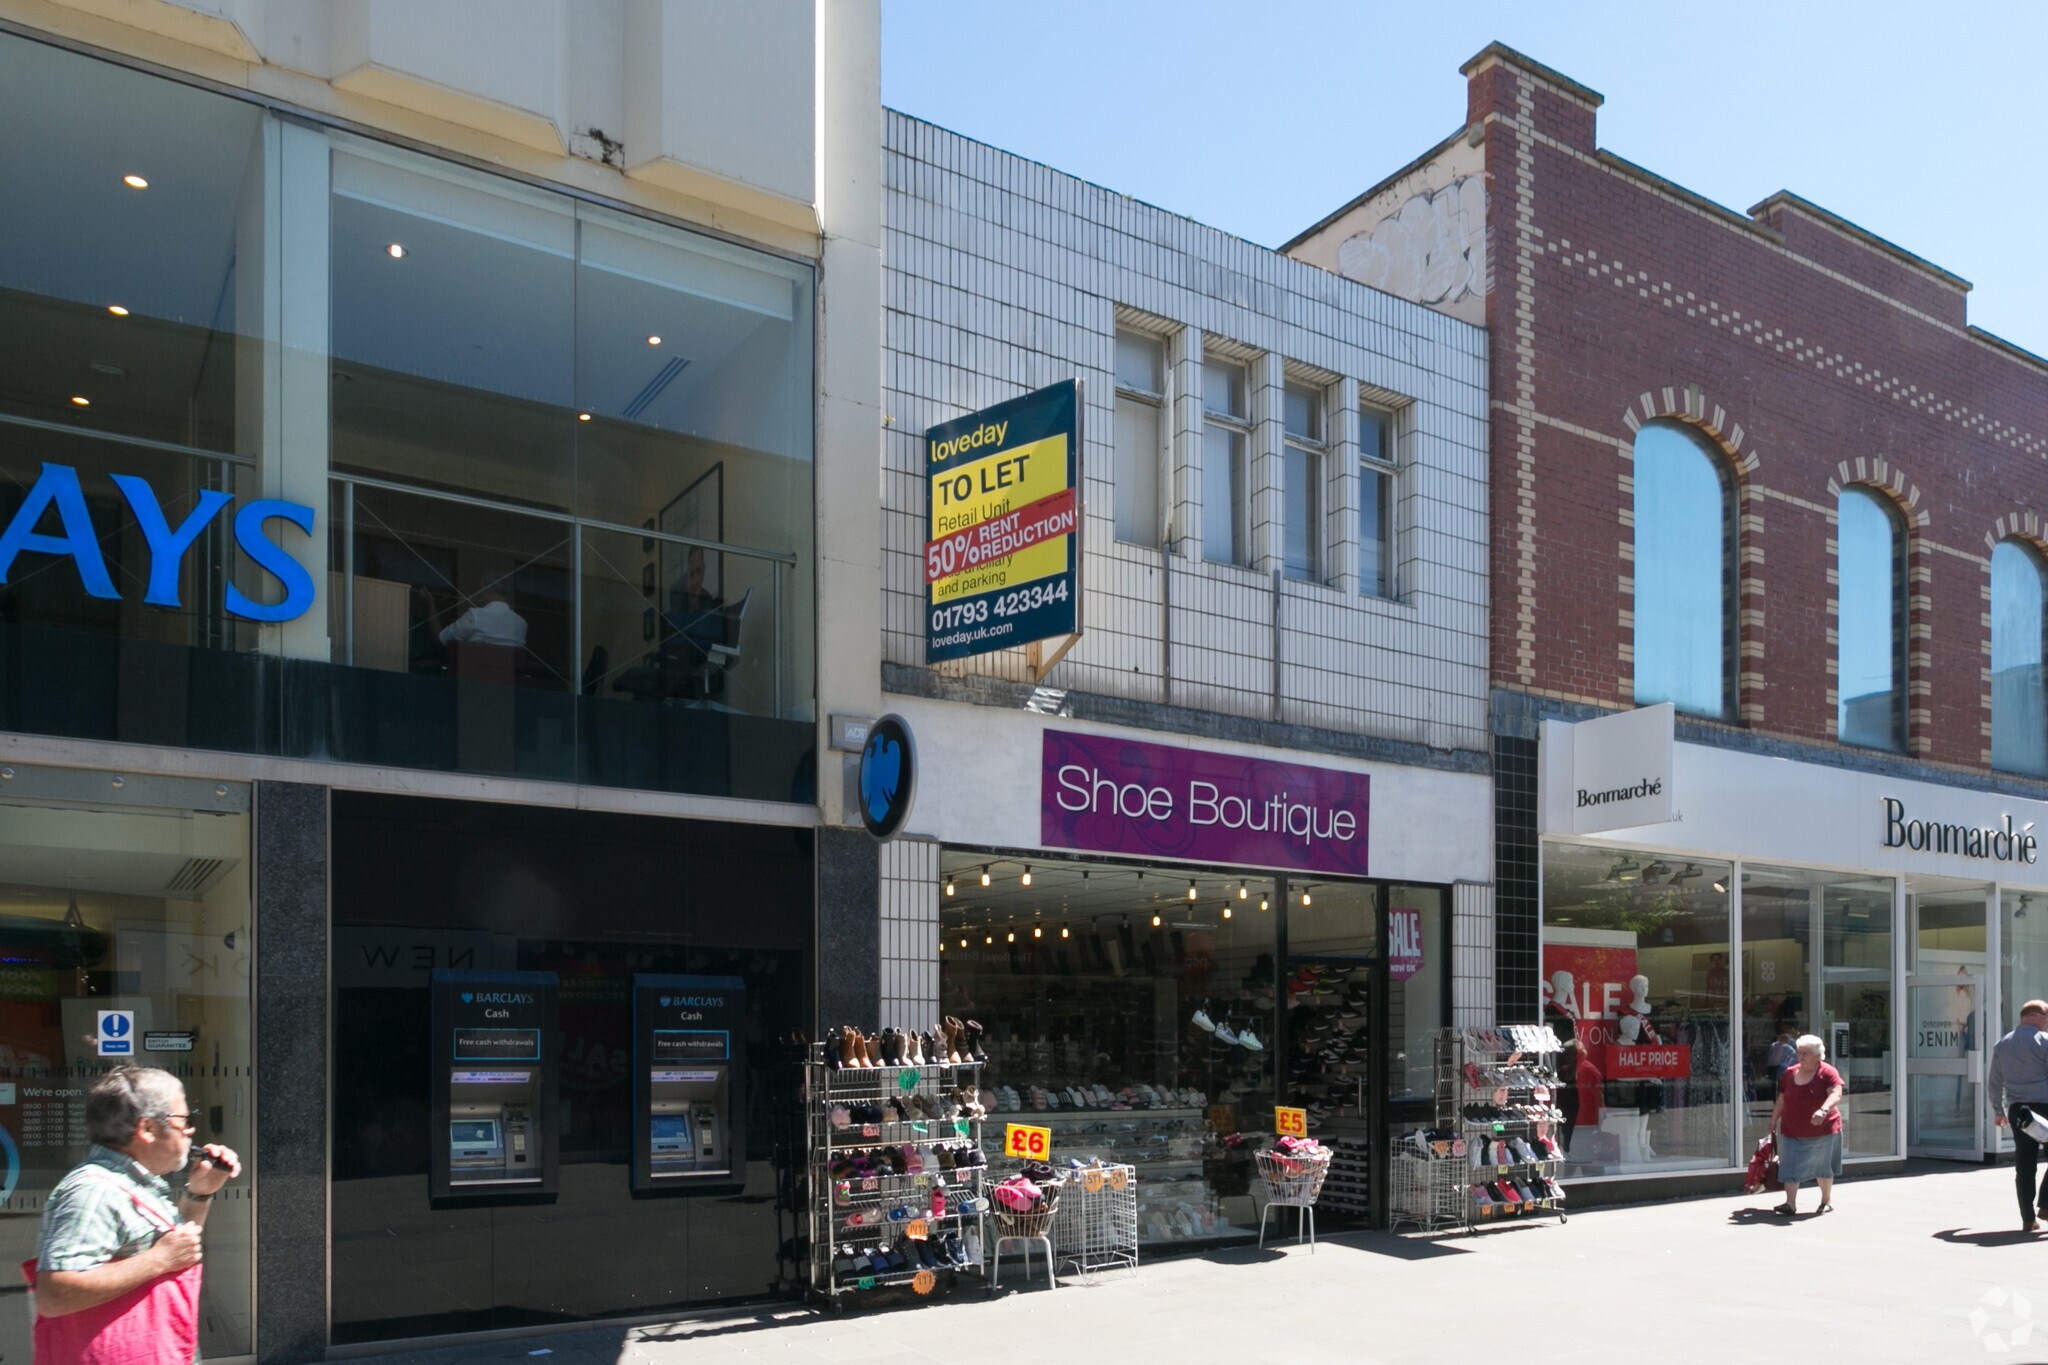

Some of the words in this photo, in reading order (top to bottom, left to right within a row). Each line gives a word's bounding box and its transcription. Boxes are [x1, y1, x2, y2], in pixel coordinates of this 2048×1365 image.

[932, 421, 1008, 462] loveday
[939, 474, 972, 506] TO
[981, 454, 1030, 493] LET
[938, 507, 977, 533] Retail
[982, 498, 1011, 521] Unit
[928, 531, 980, 578] 50%
[979, 512, 1020, 543] RENT
[980, 509, 1074, 560] REDUCTION
[938, 581, 959, 597] and
[962, 570, 1007, 593] parking
[932, 602, 989, 632] 01793
[993, 579, 1069, 617] 423344
[932, 622, 1013, 649] loveday.uk.com
[1056, 764, 1173, 821] Shoe
[1189, 780, 1357, 845] Boutique
[1576, 776, 1662, 808] Bonmarché
[1881, 796, 2037, 865] Bonmarché
[476, 992, 534, 1004] BARCLAYS
[672, 996, 724, 1008] BARCLAYS
[484, 1008, 510, 1019] Cash
[680, 1011, 702, 1021] Cash
[459, 1038, 474, 1046] Free
[475, 1038, 492, 1046] cash
[493, 1038, 534, 1046] withdrawals
[1619, 1052, 1646, 1067] HALF
[1650, 1051, 1678, 1066] PRICE
[23, 1087, 53, 1097] We're
[1279, 1111, 1303, 1133] £5
[1012, 1129, 1045, 1154] £6
